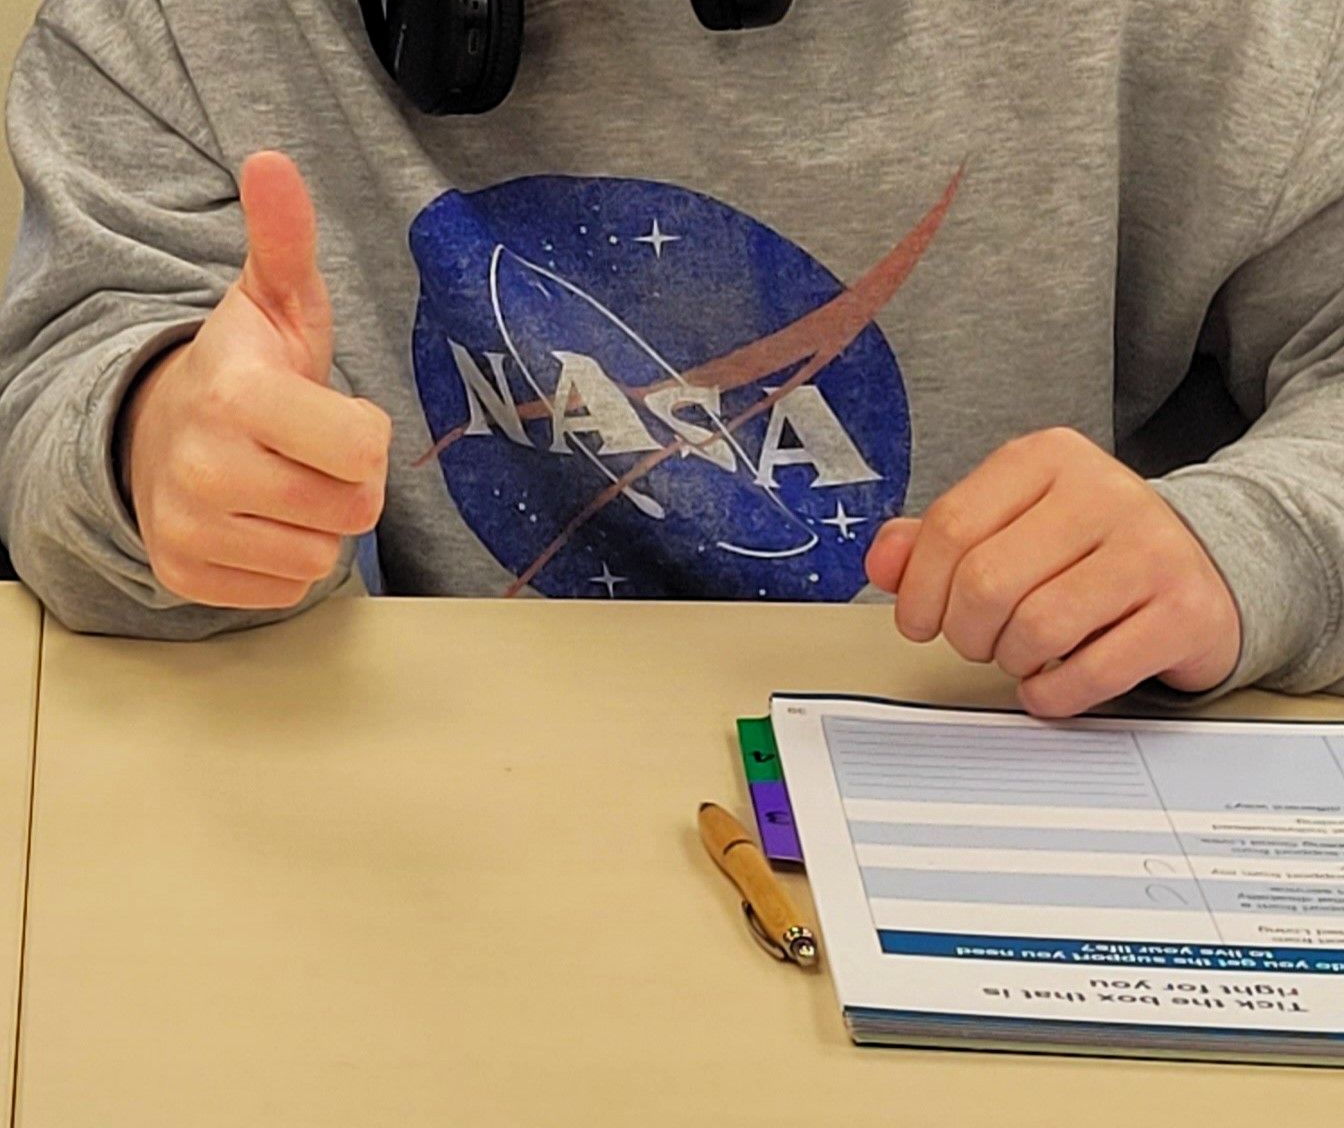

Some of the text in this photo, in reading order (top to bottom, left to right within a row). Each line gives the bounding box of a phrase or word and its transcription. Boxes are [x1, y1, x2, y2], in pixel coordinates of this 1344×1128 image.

[446, 336, 884, 488] NASA
[956, 945, 1310, 971] you get the support you need
[982, 987, 1309, 1013] Tick the box that is
[1089, 979, 1300, 997] right for you
